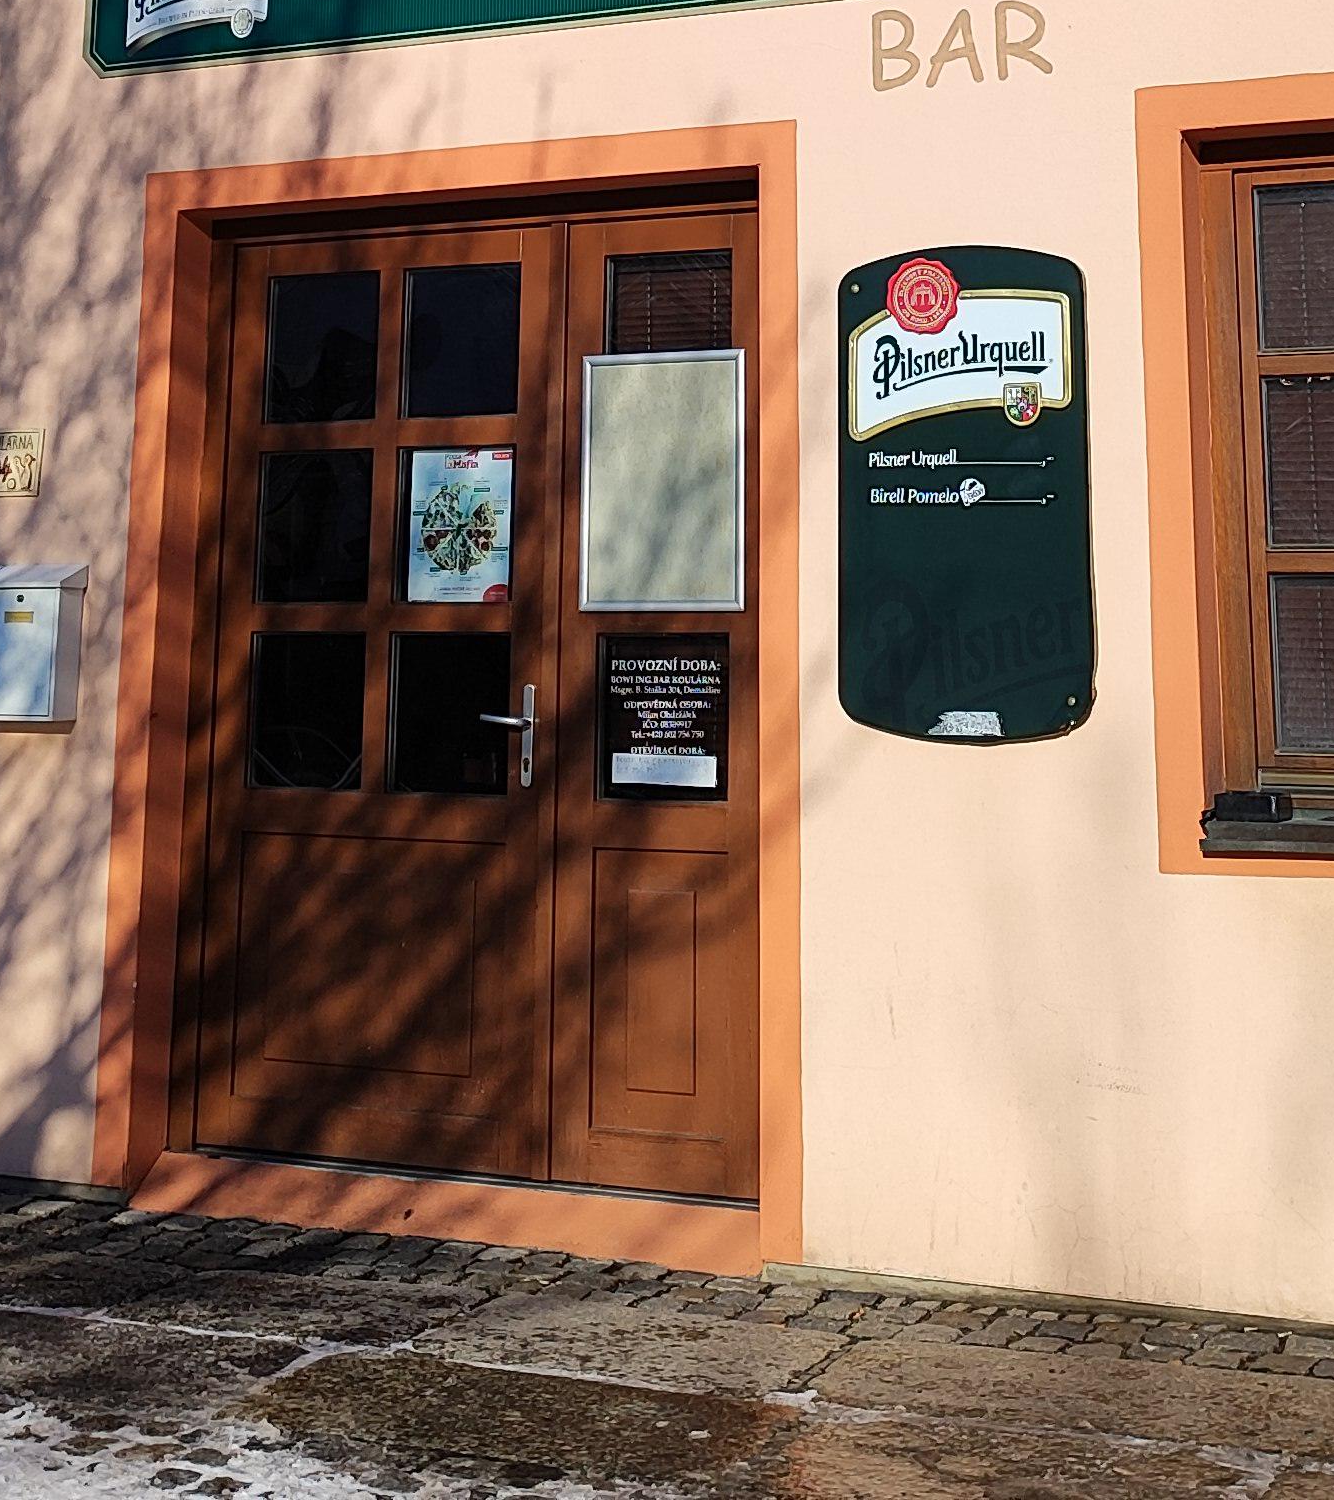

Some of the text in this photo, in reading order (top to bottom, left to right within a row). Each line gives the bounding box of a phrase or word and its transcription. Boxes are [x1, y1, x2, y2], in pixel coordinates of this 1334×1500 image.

[870, 0, 1053, 93] BAR
[872, 330, 1046, 400] Pilsner Urquell
[868, 448, 957, 470] Pilsner Urquell
[870, 487, 905, 504] Birell
[907, 487, 959, 504] Pomelo
[611, 657, 721, 671] PROVOZNÍ DOBA:
[671, 674, 721, 684] KOULÁRNA
